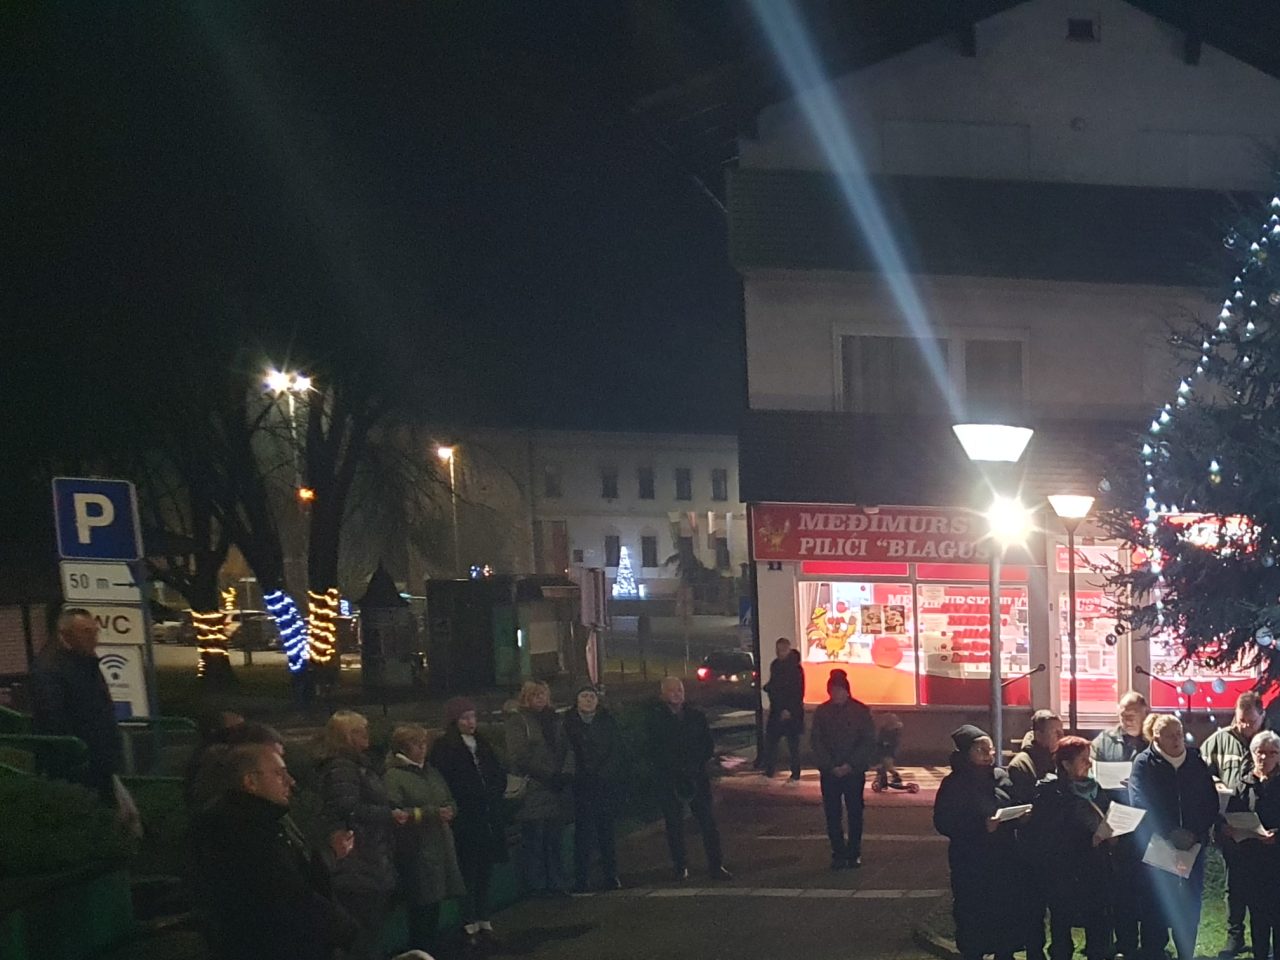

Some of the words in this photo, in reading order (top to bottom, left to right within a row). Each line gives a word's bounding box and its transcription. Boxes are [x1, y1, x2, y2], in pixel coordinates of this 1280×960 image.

[73, 493, 116, 544] P
[797, 512, 998, 535] MEĐIMURS
[797, 532, 868, 556] PILIĆI
[69, 573, 89, 589] 50
[96, 578, 109, 589] m
